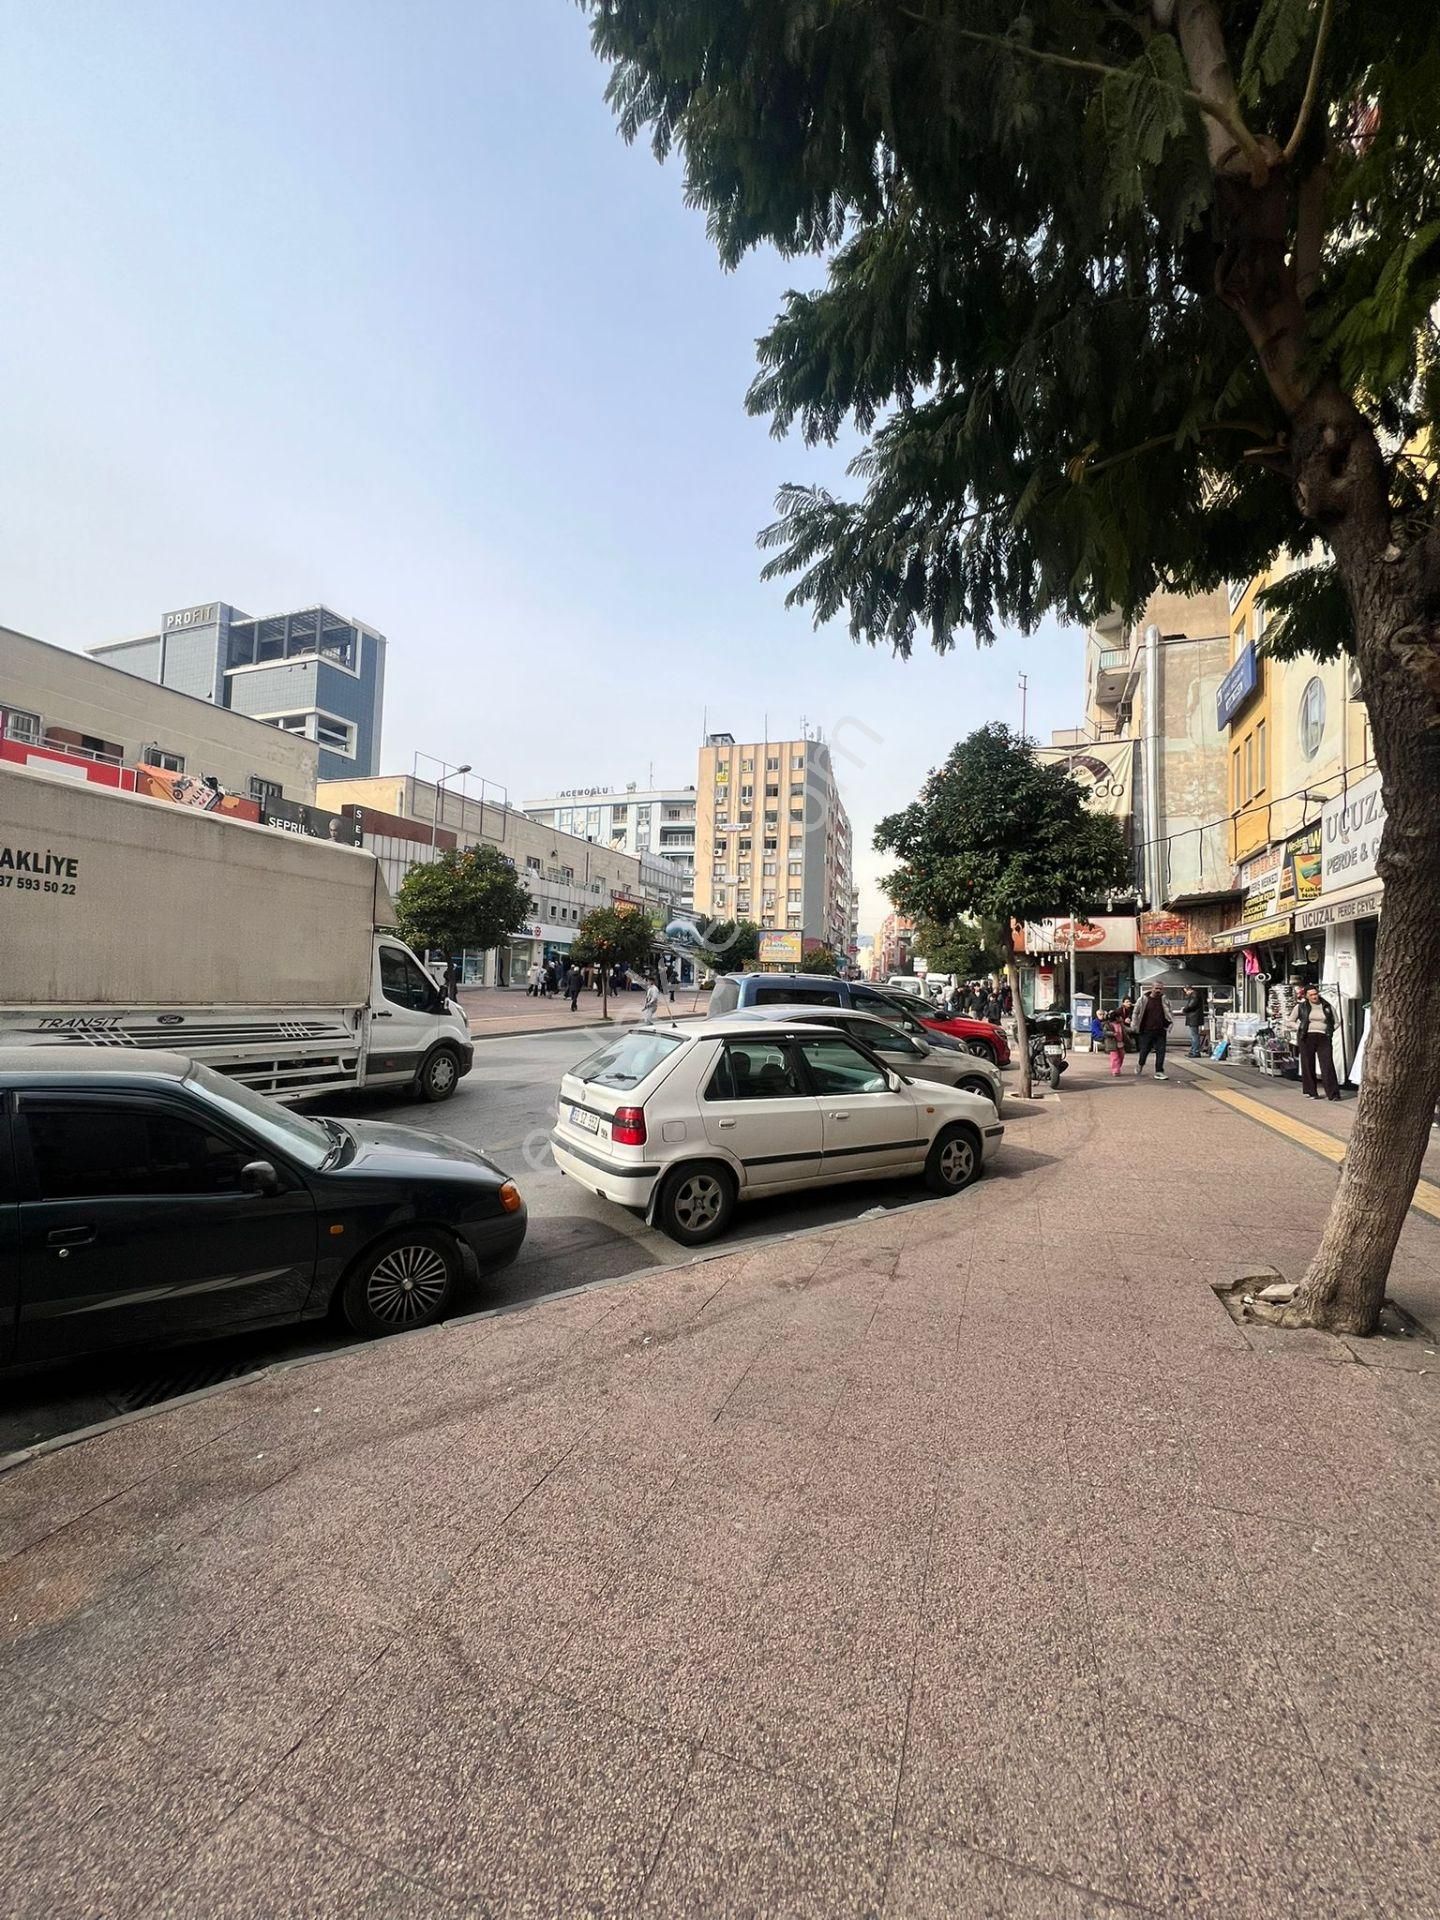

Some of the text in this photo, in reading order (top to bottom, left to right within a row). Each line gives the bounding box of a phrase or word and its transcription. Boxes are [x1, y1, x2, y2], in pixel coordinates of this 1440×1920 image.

[167, 607, 213, 628] PROFIT
[1327, 846, 1358, 876] PERDE
[17, 877, 41, 891] 593
[43, 881, 59, 893] 50
[61, 883, 76, 895] 22
[1302, 908, 1335, 928] UCUZAL
